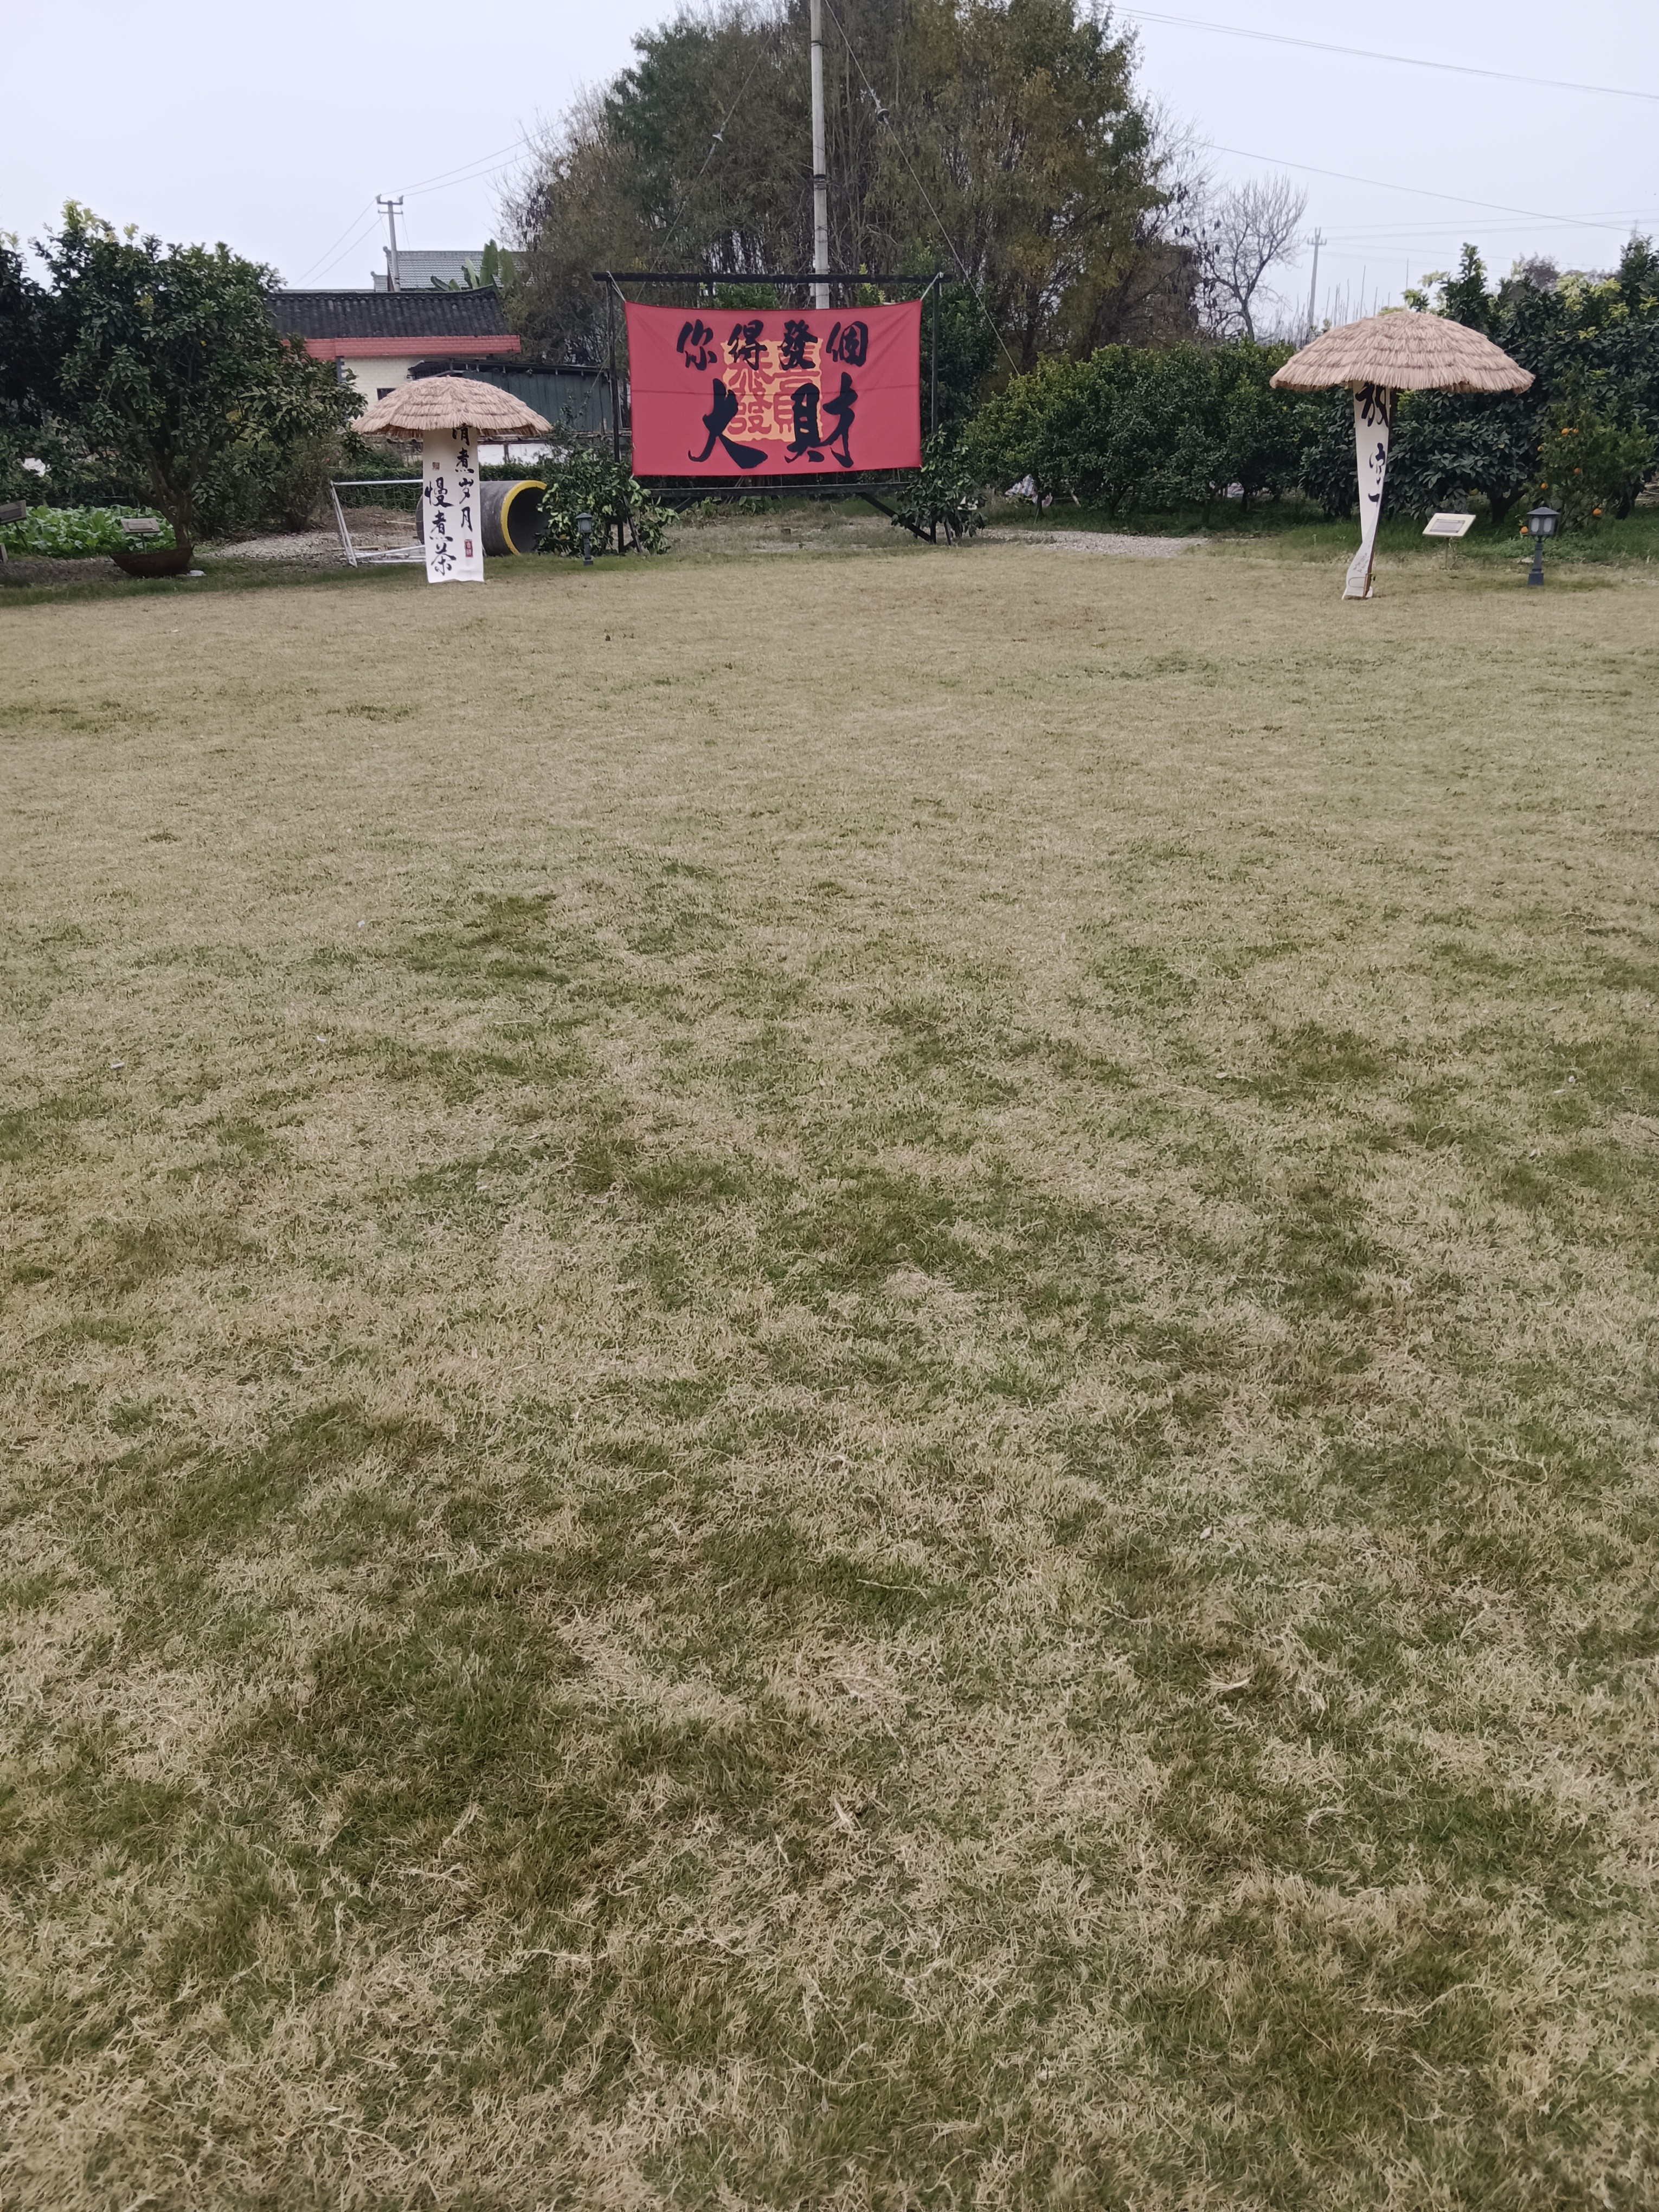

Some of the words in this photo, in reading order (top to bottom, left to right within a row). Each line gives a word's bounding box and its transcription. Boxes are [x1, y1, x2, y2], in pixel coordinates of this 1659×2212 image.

[677, 319, 869, 371] 你得發個
[687, 372, 858, 470] 大財
[424, 477, 457, 576] 慢煮茶
